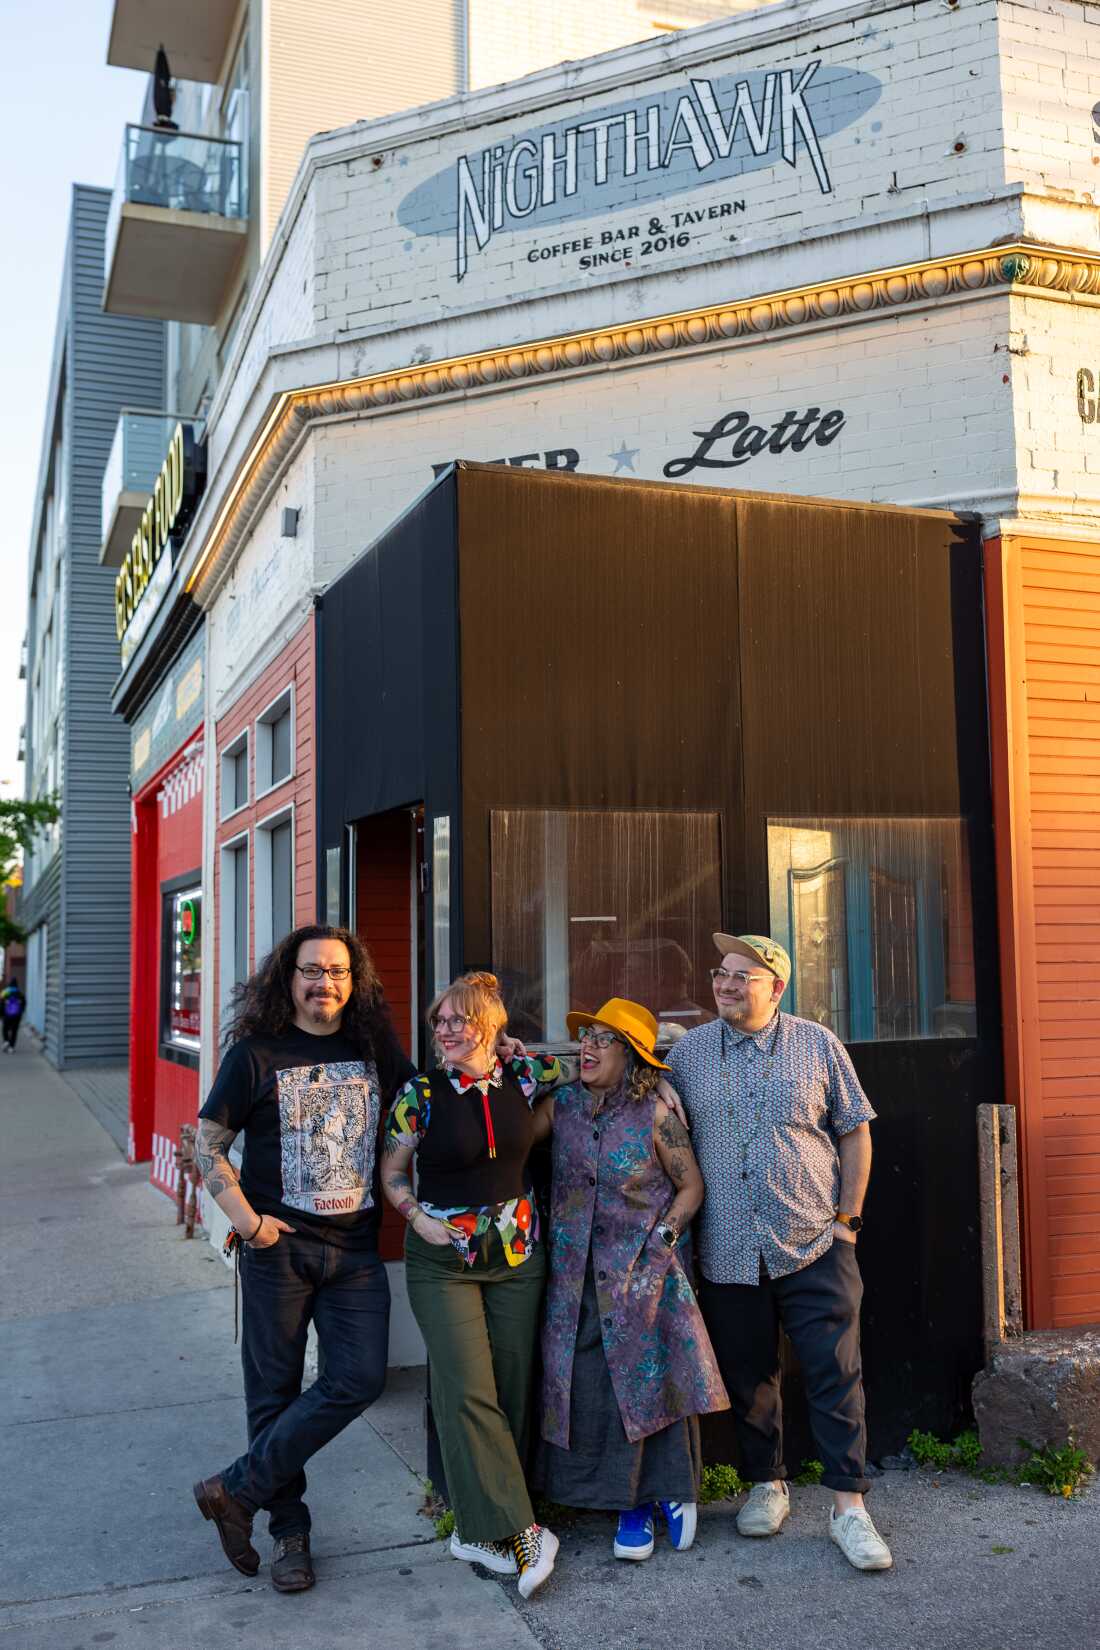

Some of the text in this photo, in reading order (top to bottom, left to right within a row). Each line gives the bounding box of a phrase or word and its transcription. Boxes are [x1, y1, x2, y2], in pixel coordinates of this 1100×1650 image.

[527, 200, 745, 263] COFFEE BAR & TAVERN
[579, 232, 690, 270] SINCE 2016
[662, 407, 847, 478] Latte
[154, 421, 184, 561] FOOD
[313, 1195, 354, 1211] Faetooth
